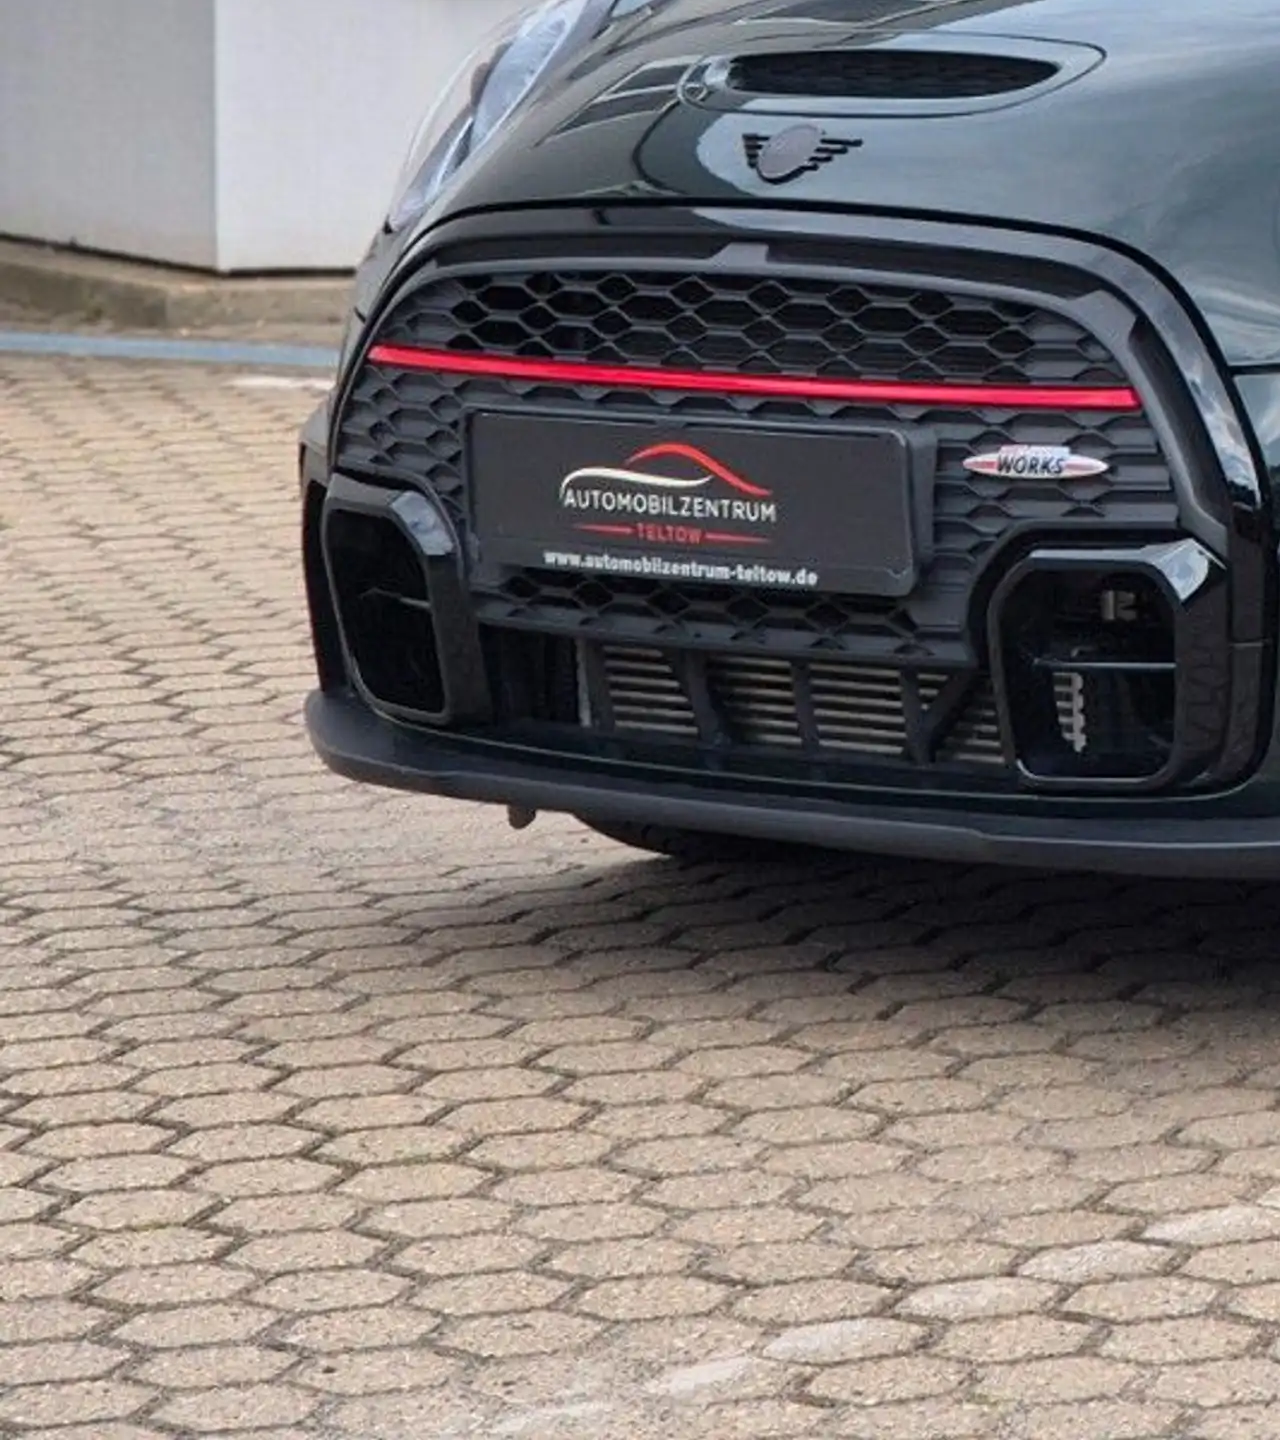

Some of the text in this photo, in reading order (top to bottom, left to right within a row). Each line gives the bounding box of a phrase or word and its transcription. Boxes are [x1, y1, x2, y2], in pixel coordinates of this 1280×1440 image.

[997, 455, 1066, 474] WORKS
[563, 488, 778, 523] AUTOMOBILZENTRUM
[636, 522, 703, 545] TELTOW
[543, 549, 819, 587] www.automobilzentrum-teltow.de
